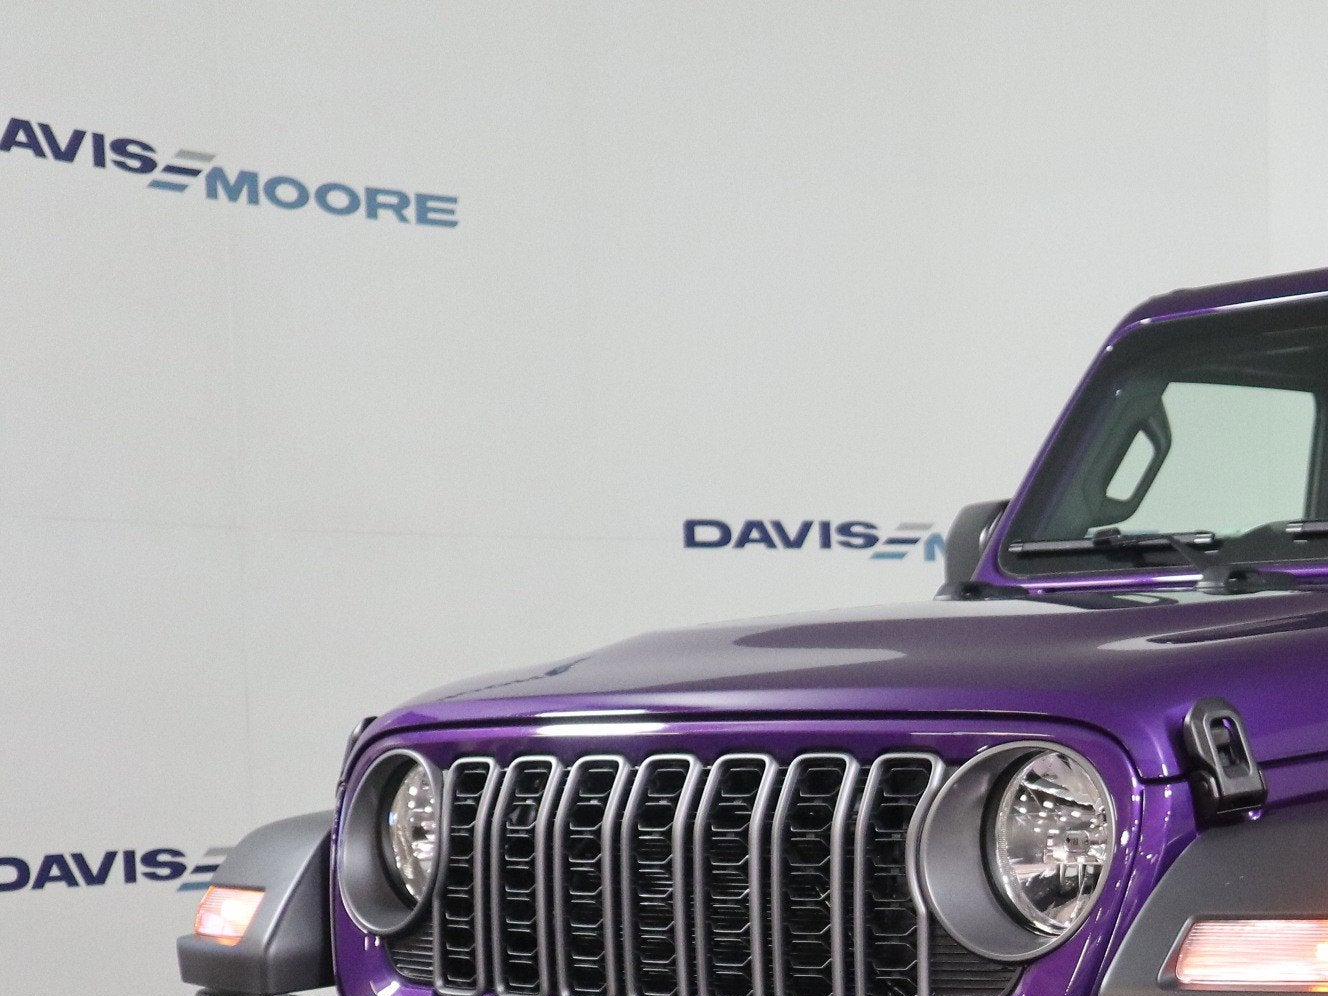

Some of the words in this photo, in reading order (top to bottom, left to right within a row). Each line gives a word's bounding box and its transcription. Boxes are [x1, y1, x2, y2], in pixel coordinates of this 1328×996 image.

[0, 117, 158, 175] AVIS
[205, 166, 459, 229] MOORE
[683, 518, 880, 550] DAVIS
[0, 848, 188, 892] DAVIS
